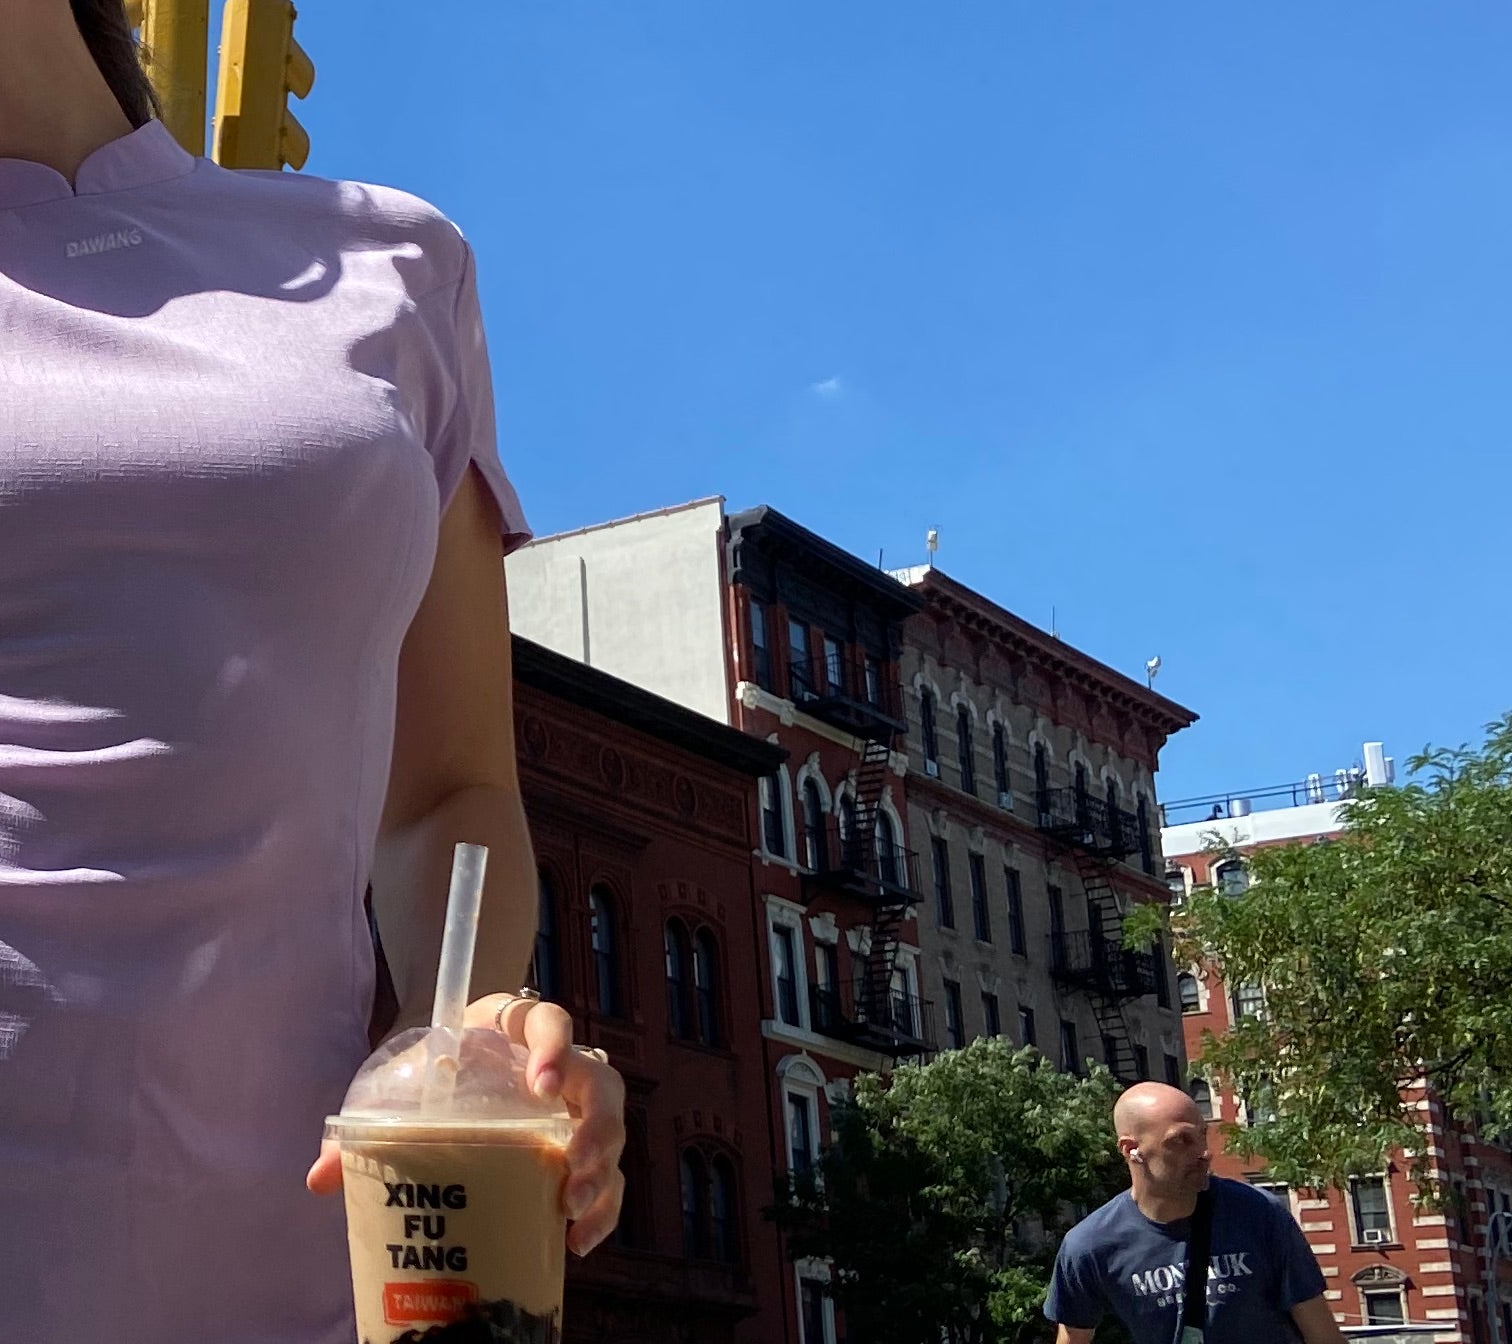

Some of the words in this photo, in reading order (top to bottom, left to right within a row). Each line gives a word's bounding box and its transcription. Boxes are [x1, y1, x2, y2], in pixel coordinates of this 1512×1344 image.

[384, 1182, 467, 1210] XING
[404, 1214, 446, 1240] FU
[386, 1244, 468, 1272] TANG
[1131, 1252, 1253, 1296] MONUK
[392, 1293, 467, 1312] TAIWAN
